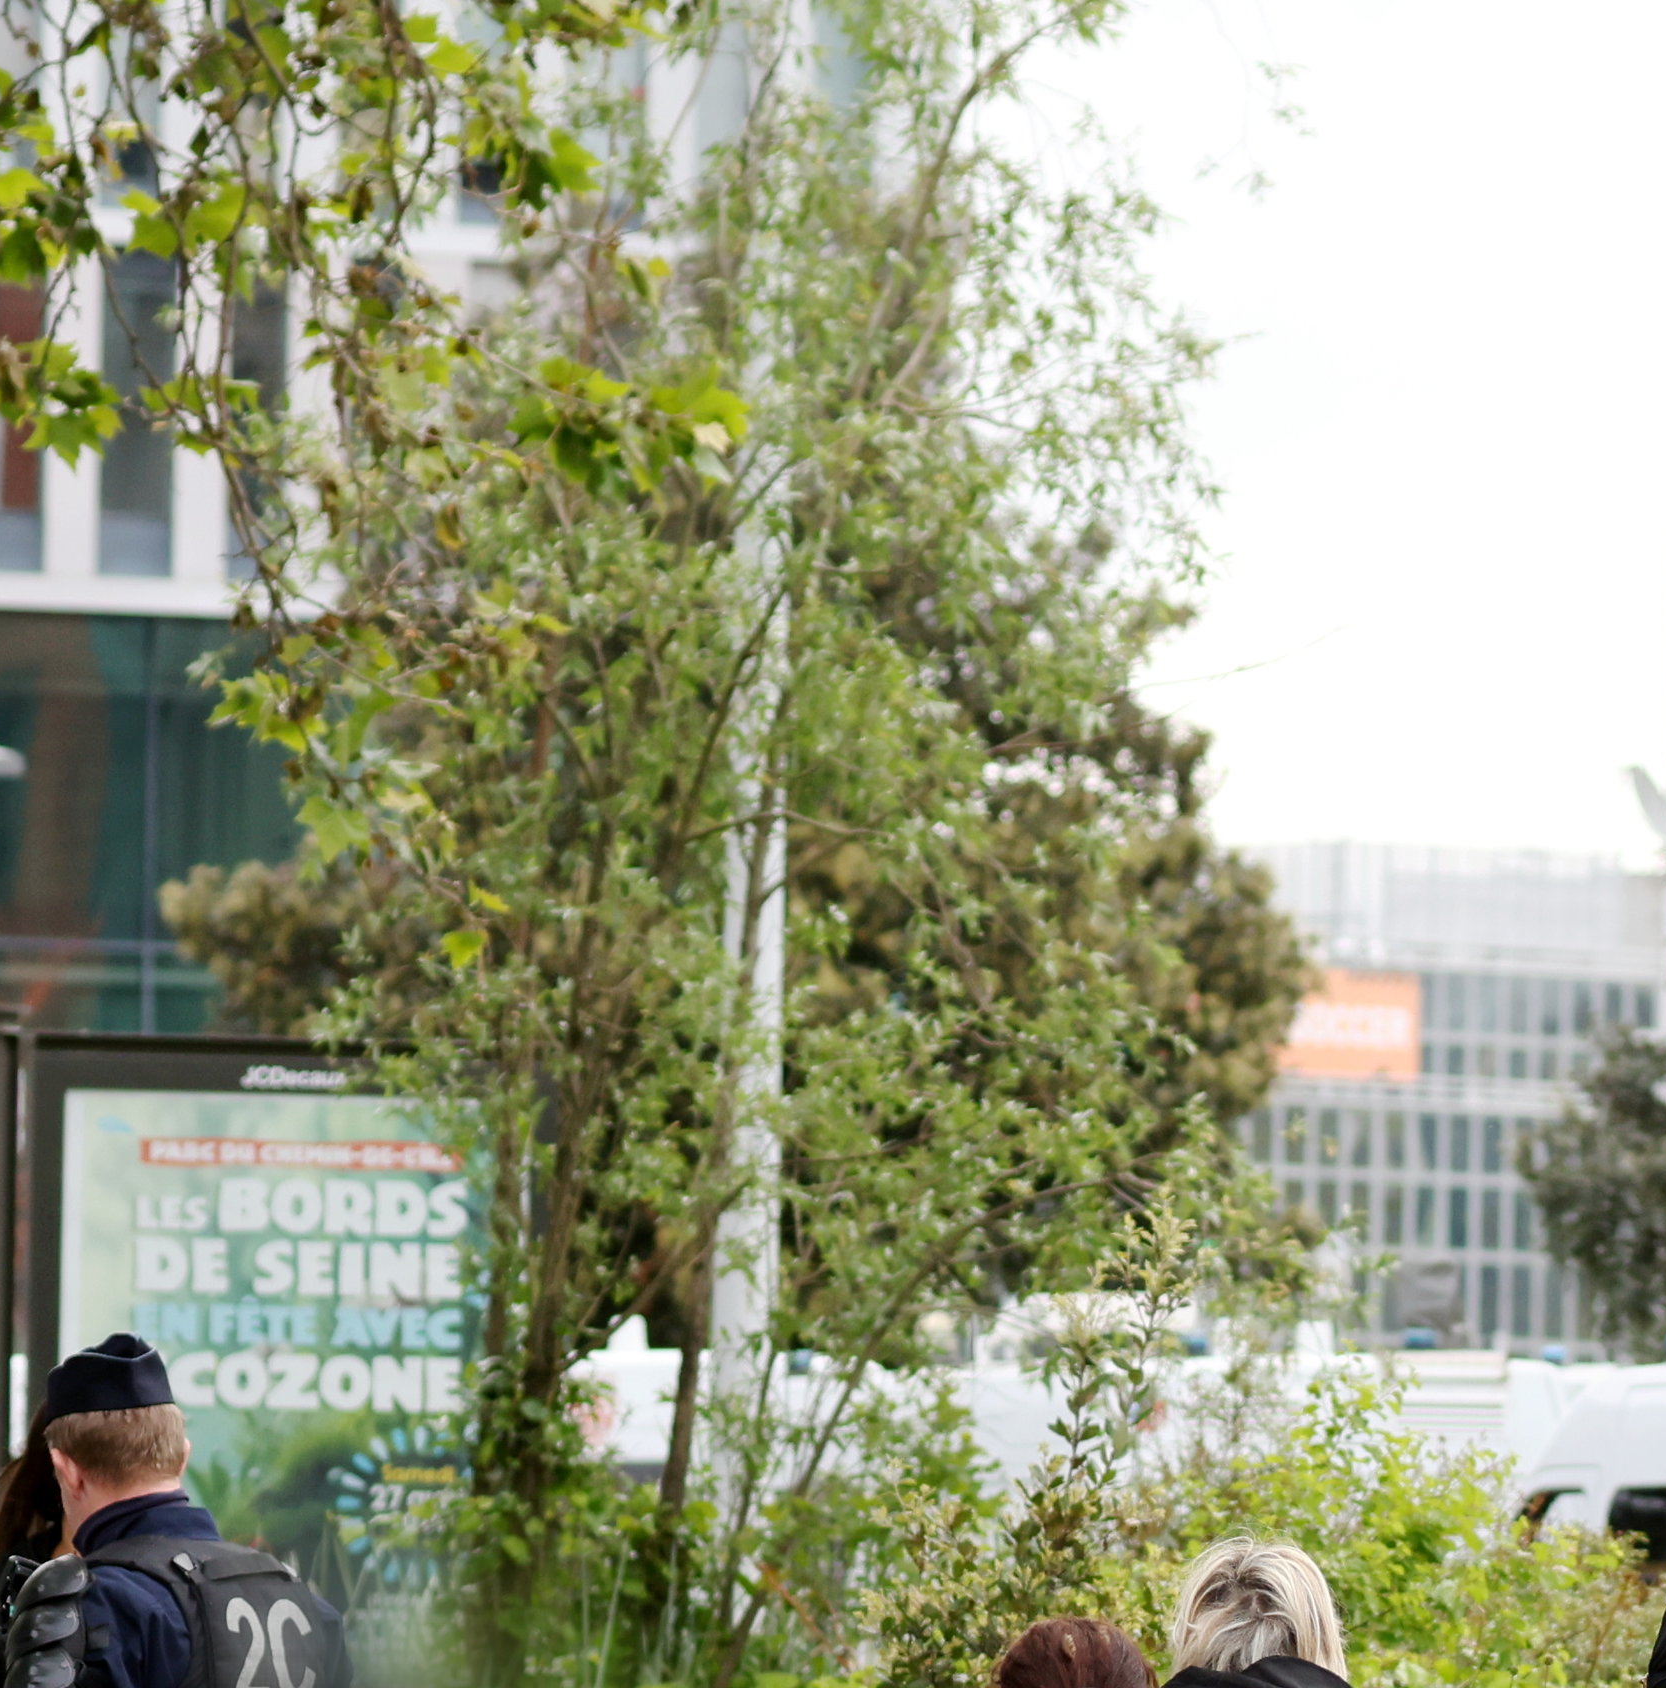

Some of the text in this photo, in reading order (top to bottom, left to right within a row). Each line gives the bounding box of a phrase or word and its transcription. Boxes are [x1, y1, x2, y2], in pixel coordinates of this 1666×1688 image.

[135, 1177, 469, 1237] LES BORDS
[135, 1236, 462, 1298] DE SEINE
[135, 1302, 197, 1344] EN
[331, 1306, 464, 1349] AVEC
[169, 1351, 463, 1413] COZONE
